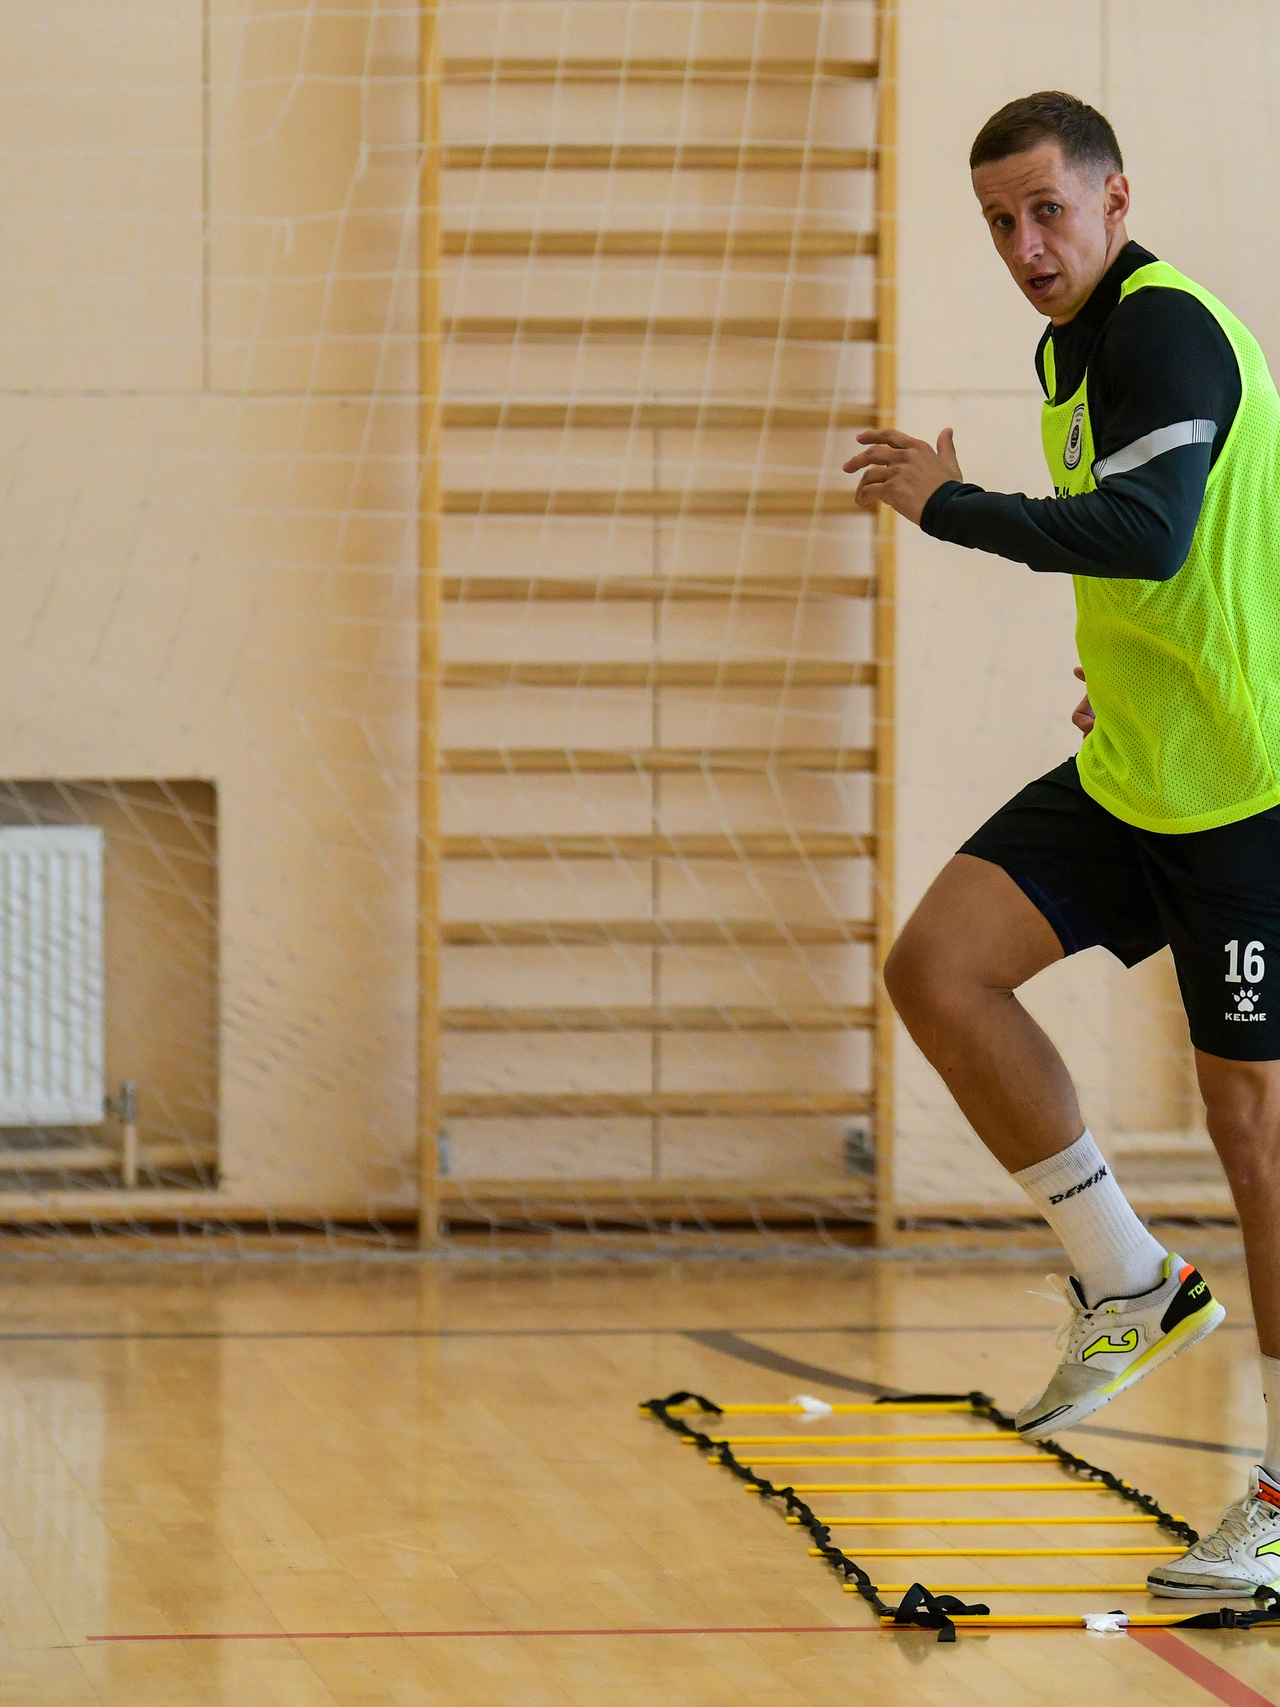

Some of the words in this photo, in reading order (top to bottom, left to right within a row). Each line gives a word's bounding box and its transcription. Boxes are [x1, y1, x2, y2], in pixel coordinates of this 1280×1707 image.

[1224, 939, 1266, 984] 16
[1224, 1012, 1267, 1022] KELME
[1049, 1165, 1107, 1205] DEMIX
